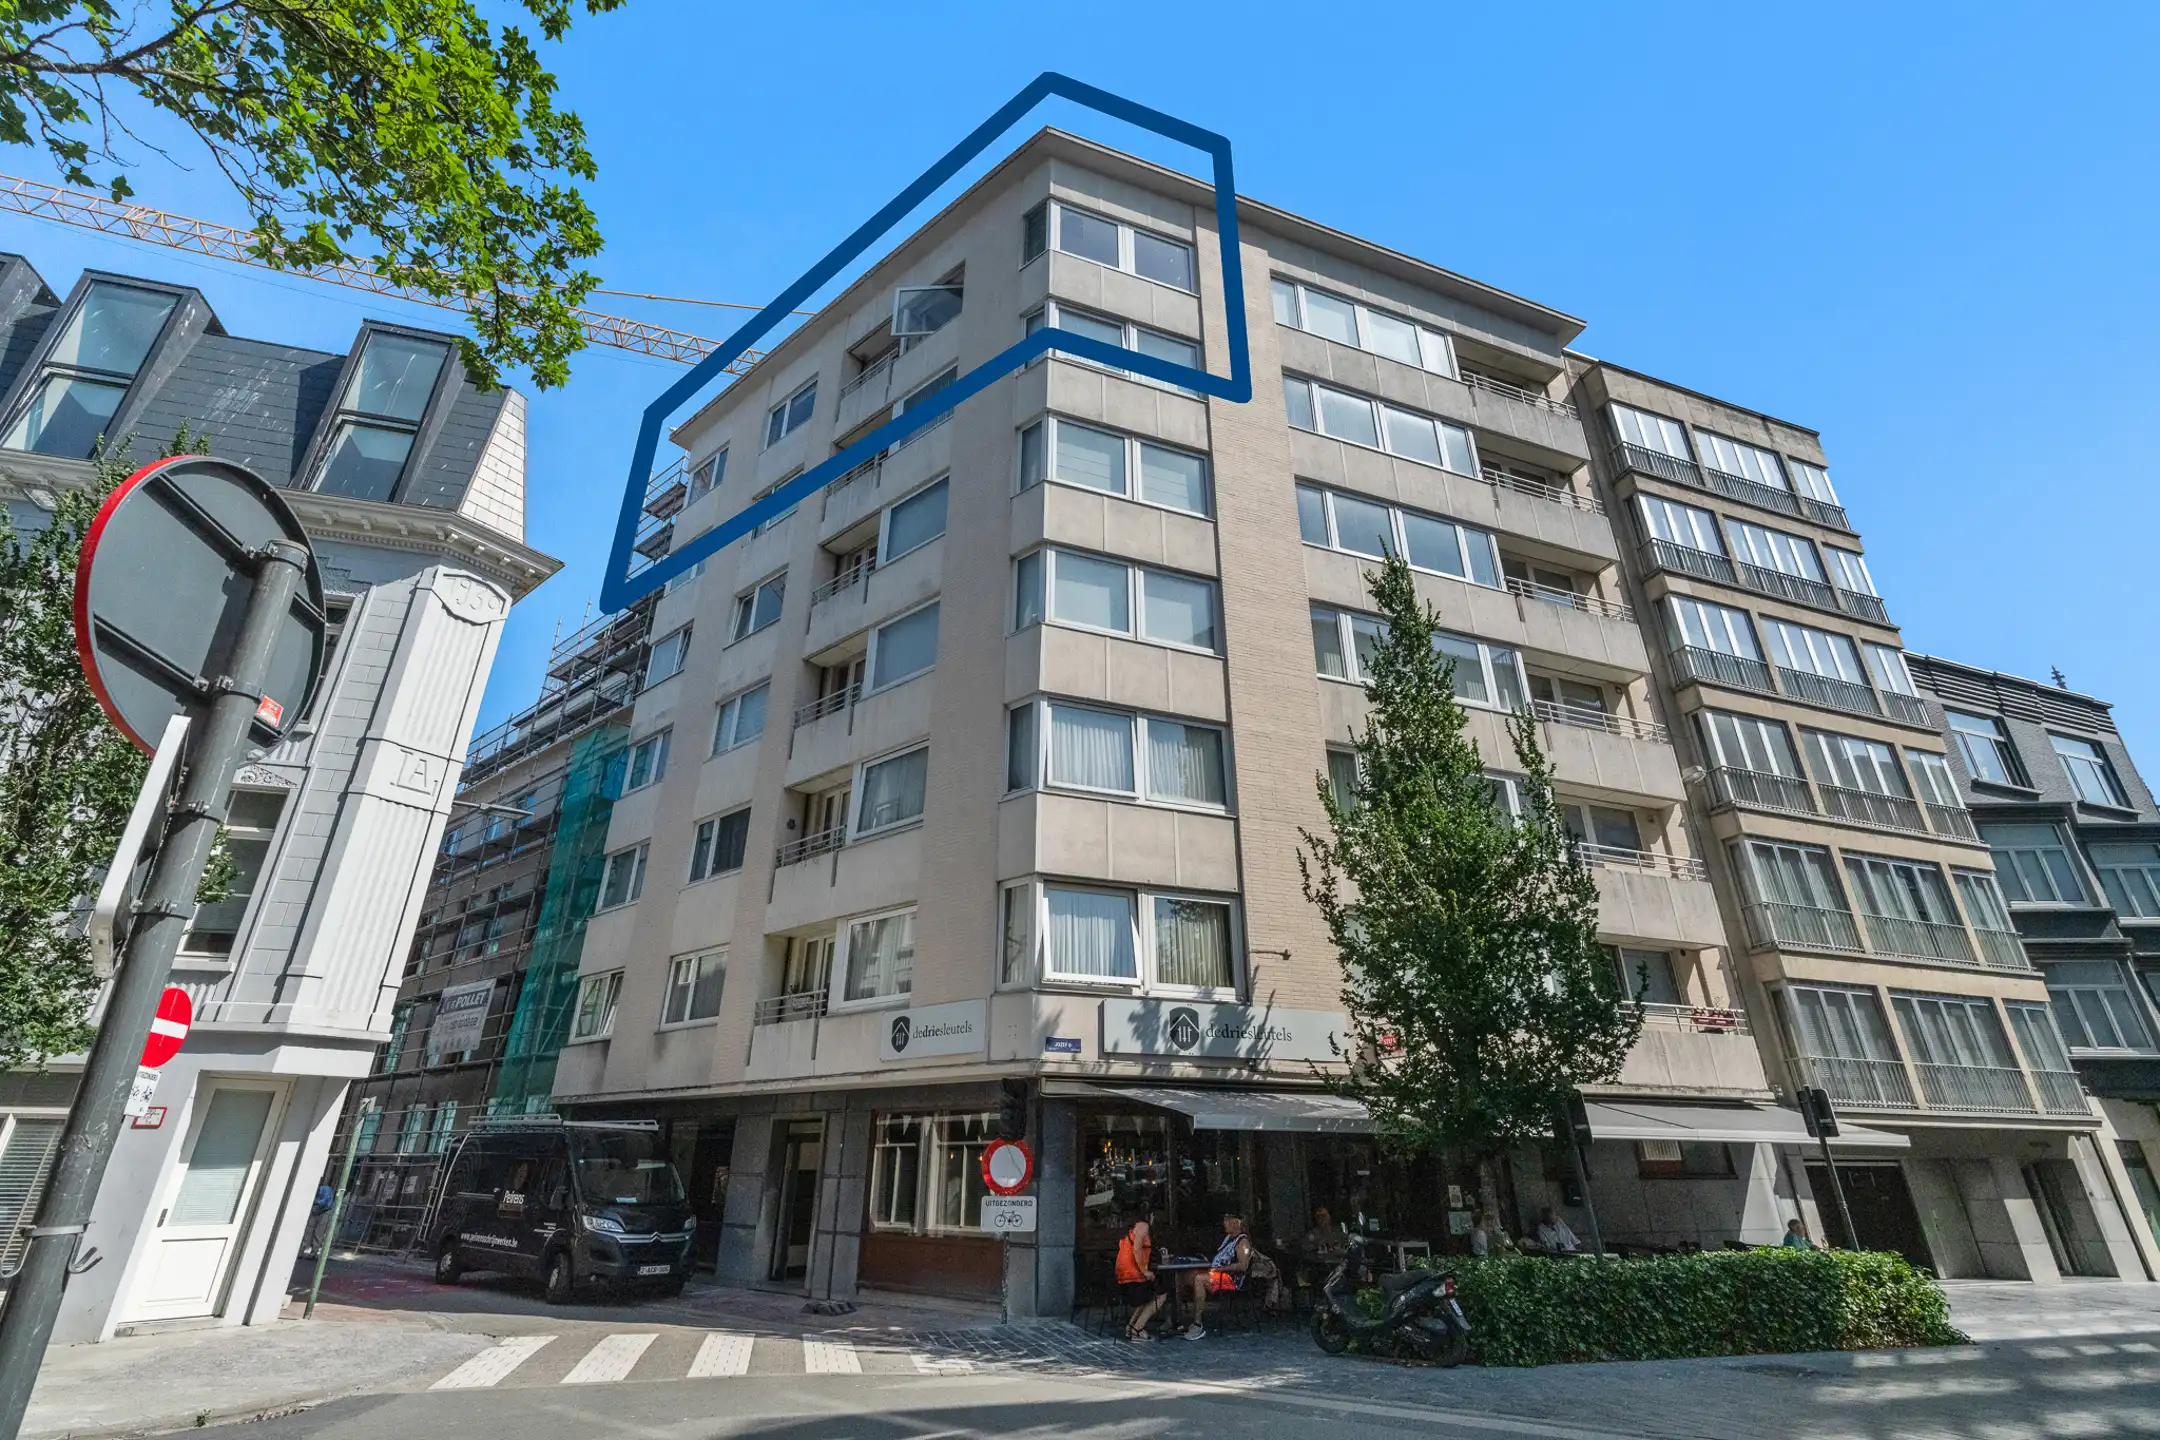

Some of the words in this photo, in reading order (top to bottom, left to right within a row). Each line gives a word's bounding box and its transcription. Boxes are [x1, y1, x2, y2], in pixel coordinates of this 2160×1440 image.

[455, 992, 486, 1009] POLLET
[912, 1020, 973, 1039] dedriesleutels
[1205, 1023, 1293, 1041] dedriesleutels
[985, 1199, 1033, 1207] UITGEZONDERD
